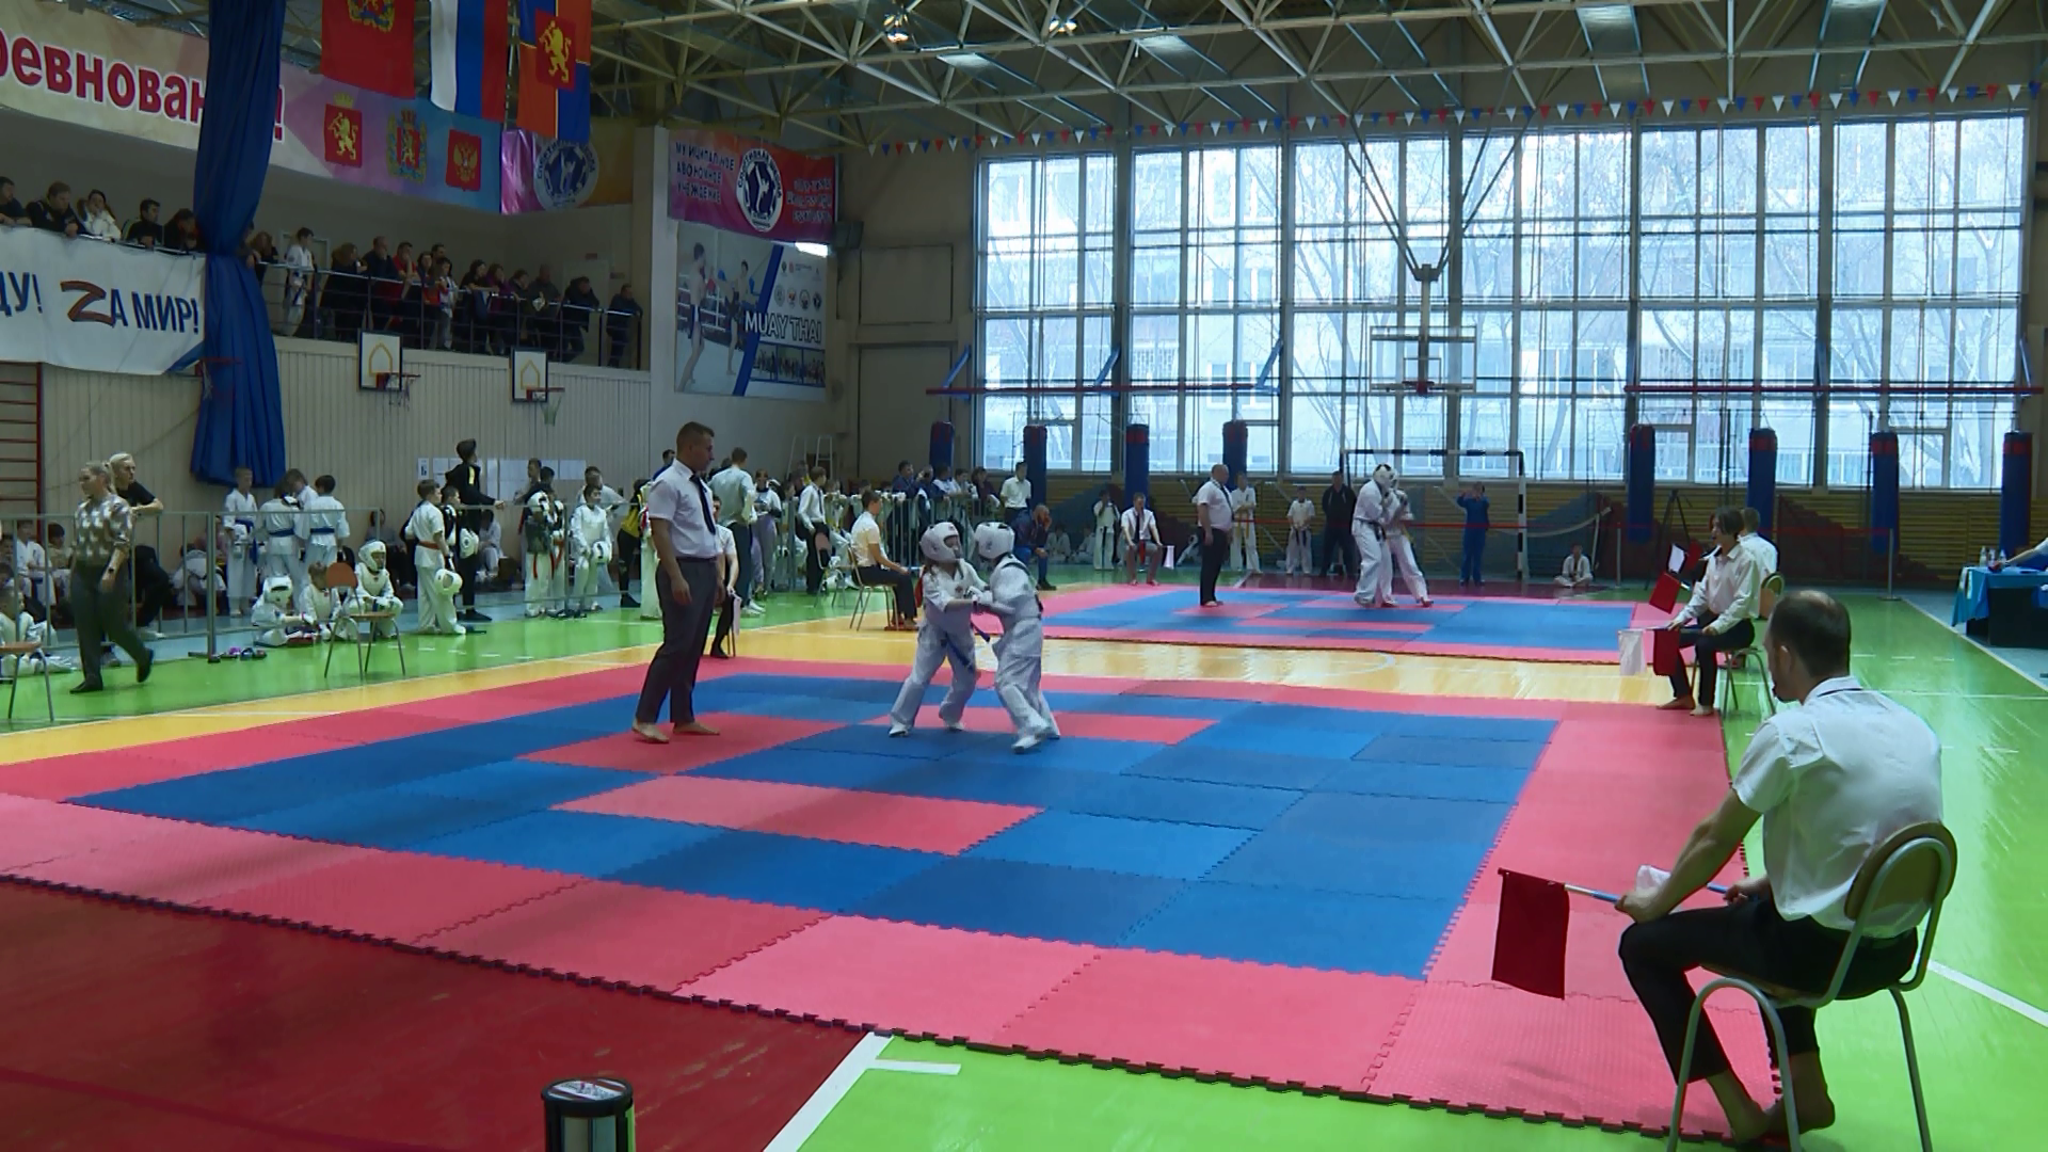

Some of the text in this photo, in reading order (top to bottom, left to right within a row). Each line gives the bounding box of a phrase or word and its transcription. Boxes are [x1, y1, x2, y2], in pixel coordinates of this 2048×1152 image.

[131, 291, 199, 335] МИР!
[744, 310, 822, 344] MUAY THAI
